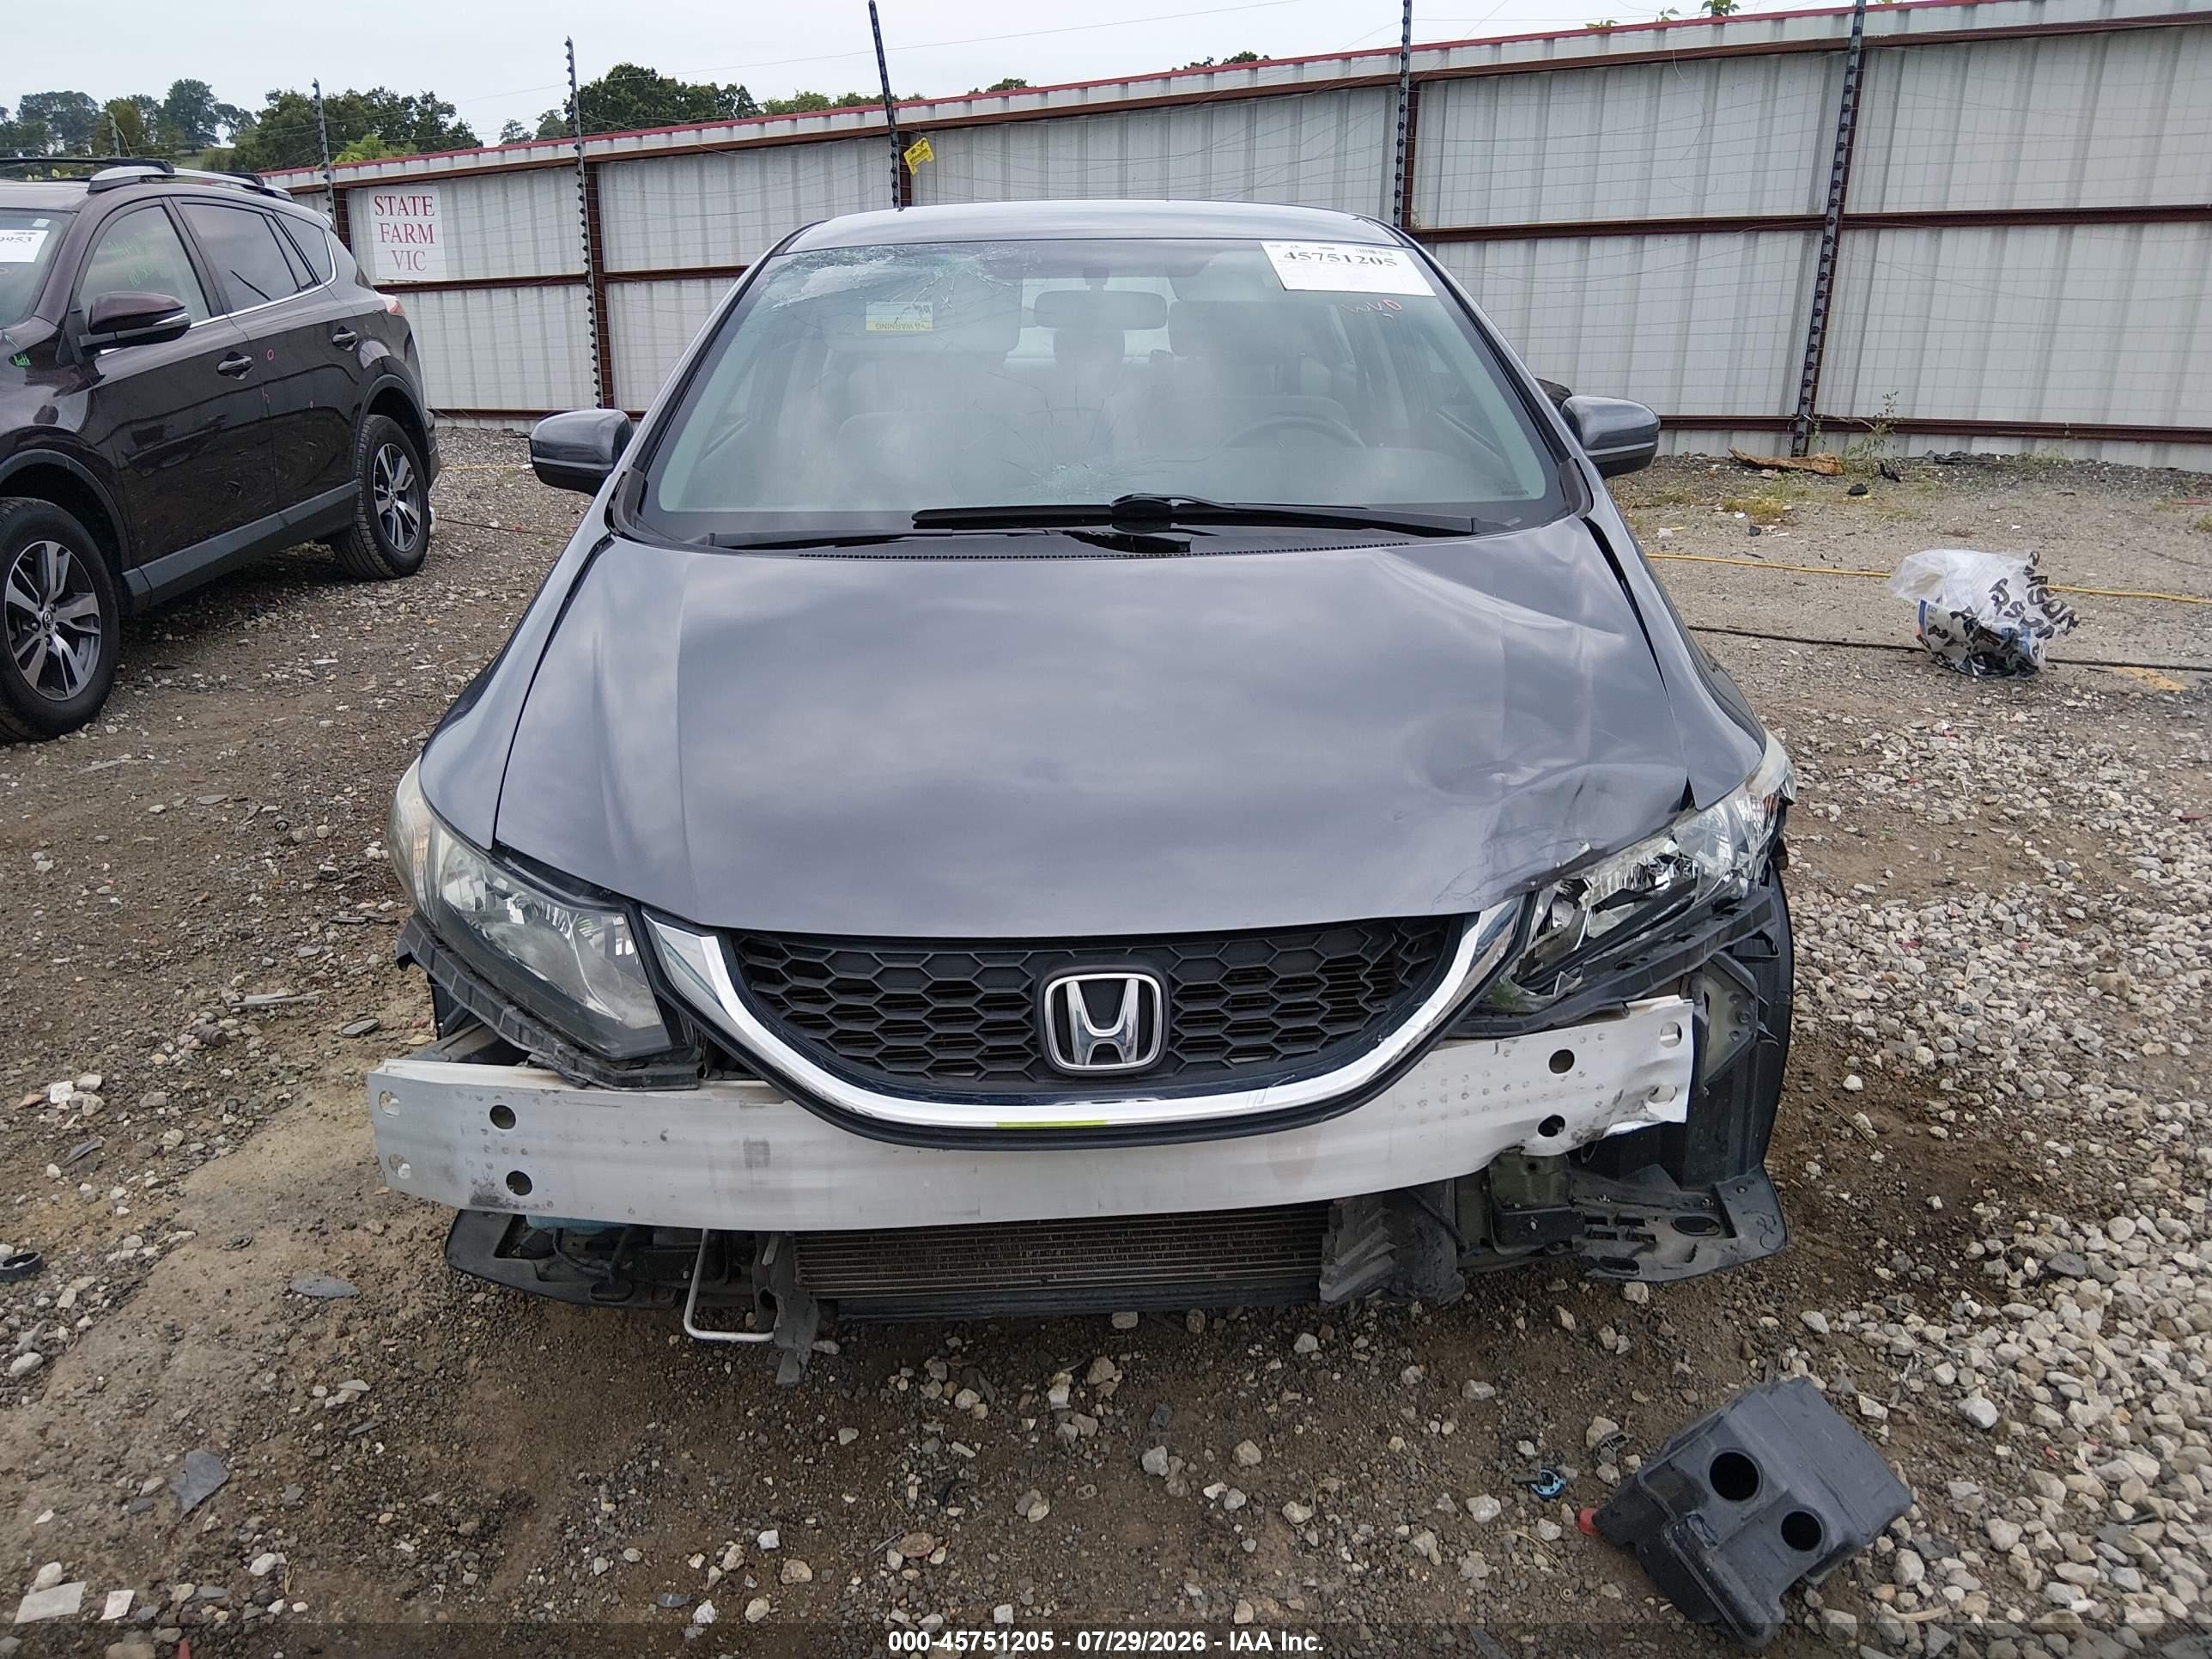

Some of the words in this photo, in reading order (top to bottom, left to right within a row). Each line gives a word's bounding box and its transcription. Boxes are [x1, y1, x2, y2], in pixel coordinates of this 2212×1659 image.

[374, 196, 435, 216] STATE
[380, 223, 434, 244] FARM
[392, 250, 427, 270] VIC
[1284, 251, 1399, 267] 45751205
